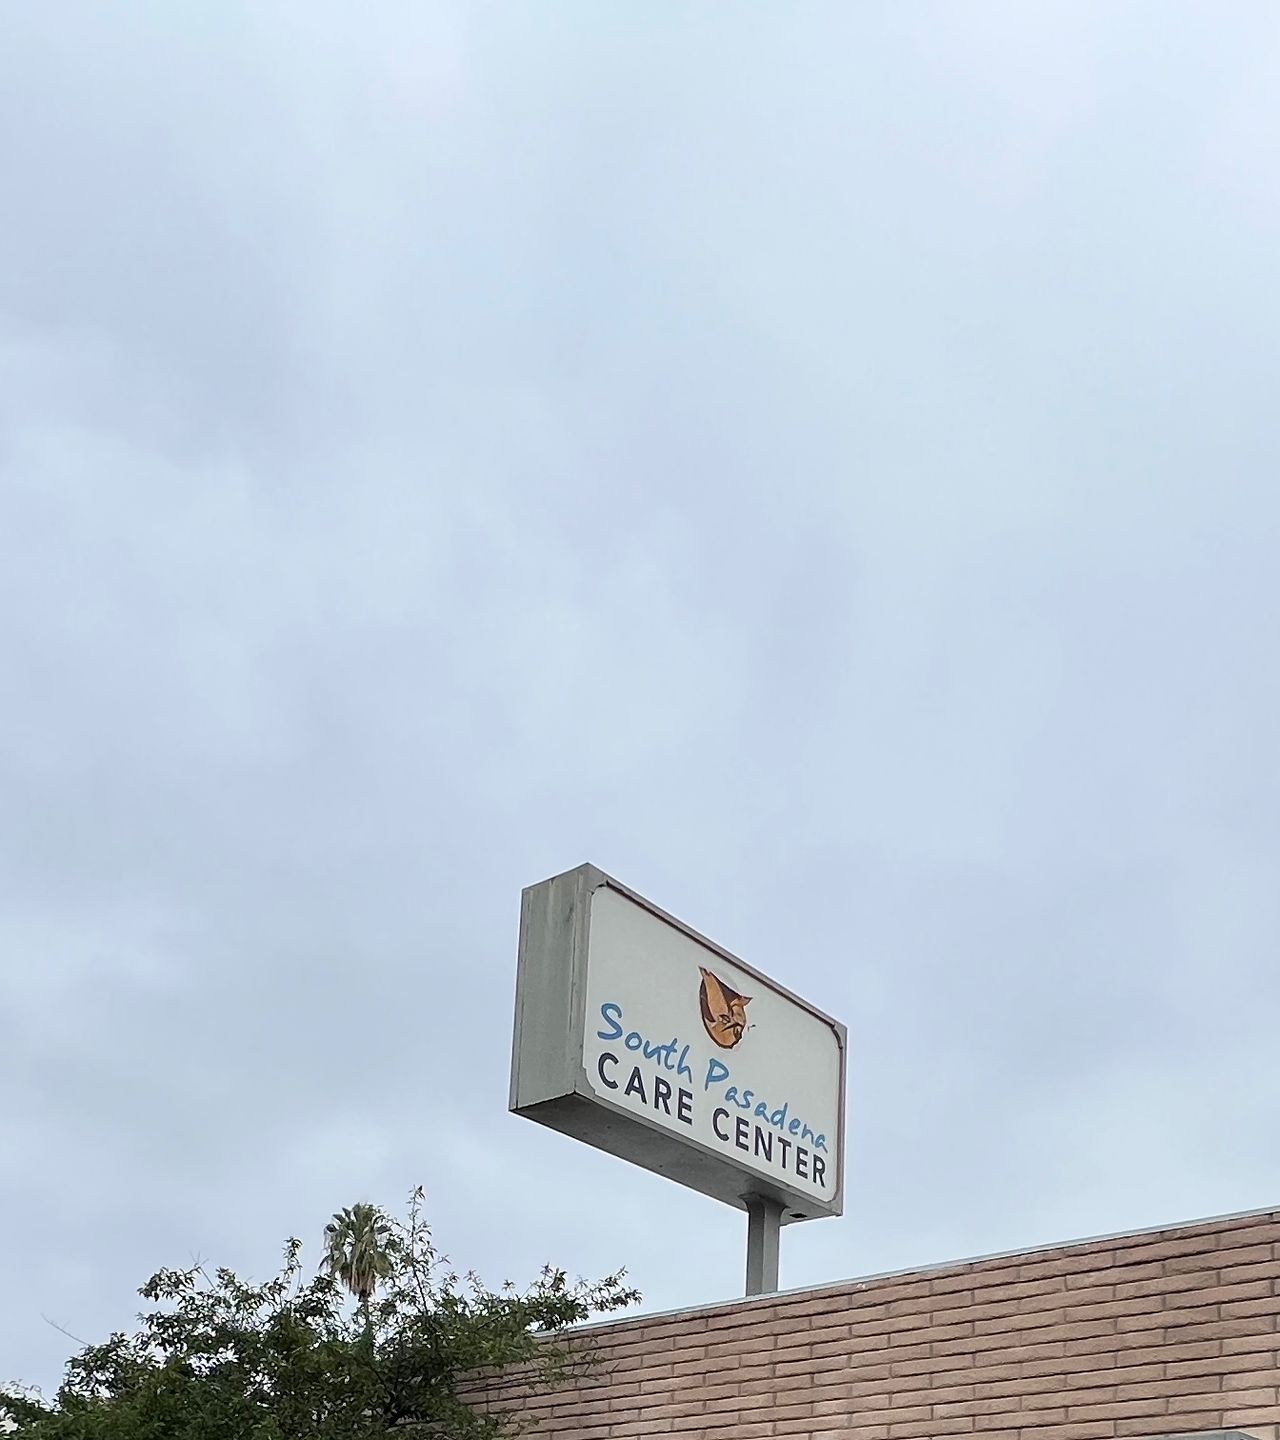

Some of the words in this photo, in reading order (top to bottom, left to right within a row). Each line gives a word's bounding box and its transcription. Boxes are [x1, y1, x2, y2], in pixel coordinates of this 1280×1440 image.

[597, 1003, 692, 1084] South
[705, 1058, 827, 1152] Pasadena
[597, 1052, 693, 1125] CARE
[712, 1108, 826, 1188] CENTER
